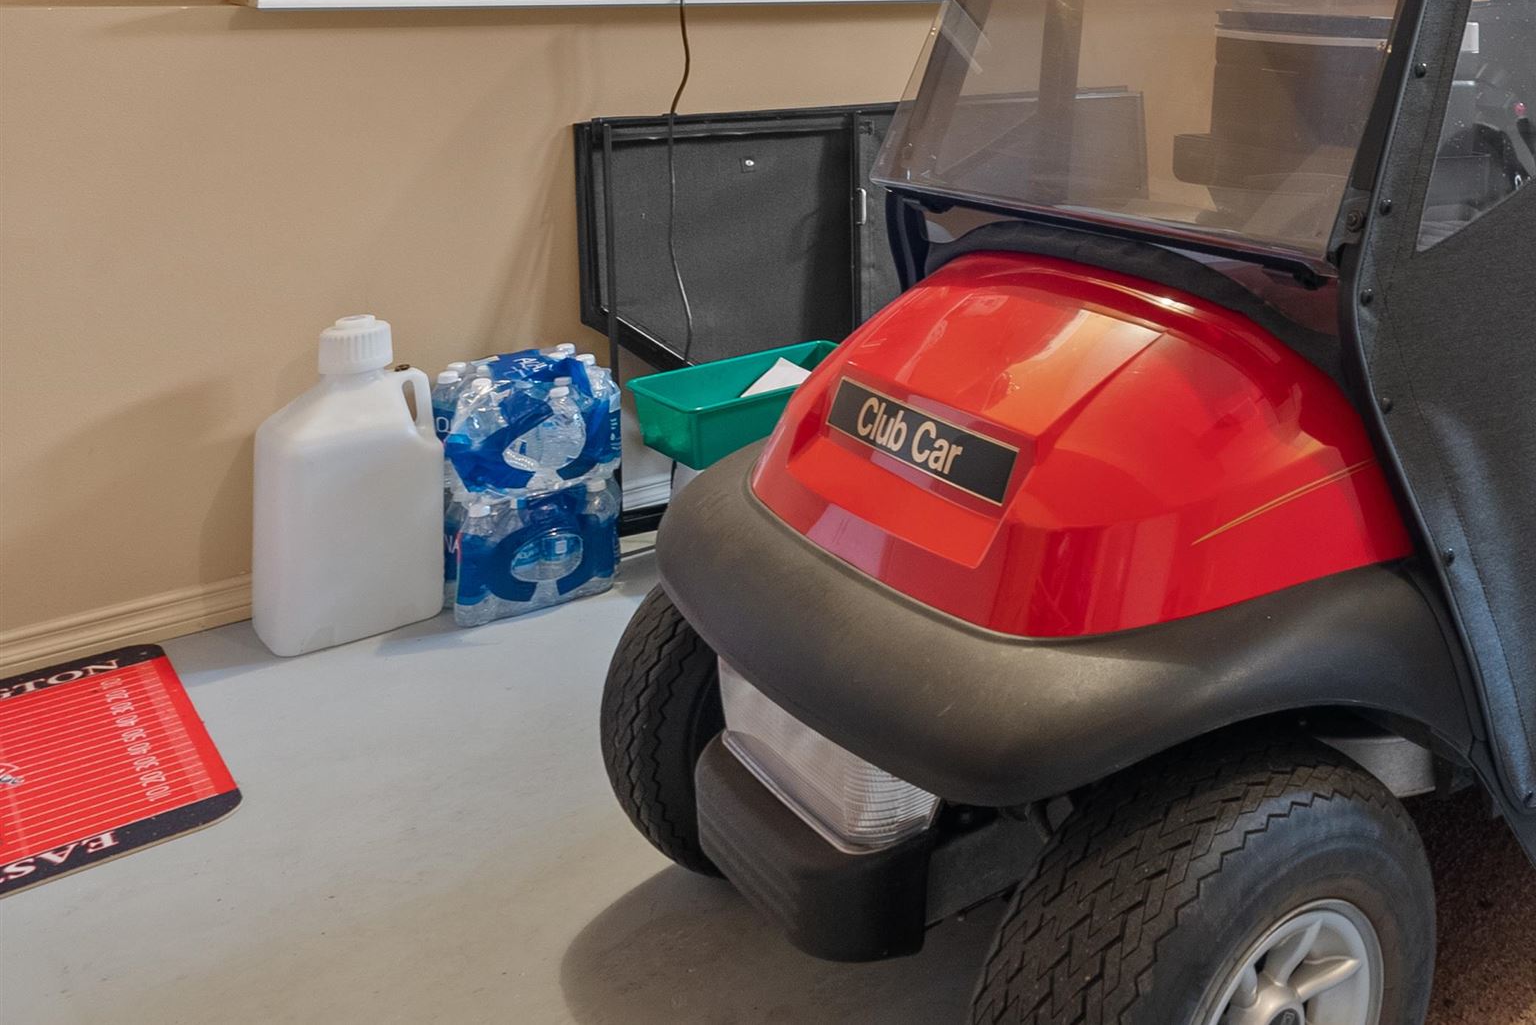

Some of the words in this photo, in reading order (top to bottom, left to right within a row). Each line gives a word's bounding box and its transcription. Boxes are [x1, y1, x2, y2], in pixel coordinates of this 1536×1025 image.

[856, 397, 908, 452] Club
[911, 421, 963, 474] Car
[0, 830, 119, 883] EAS
